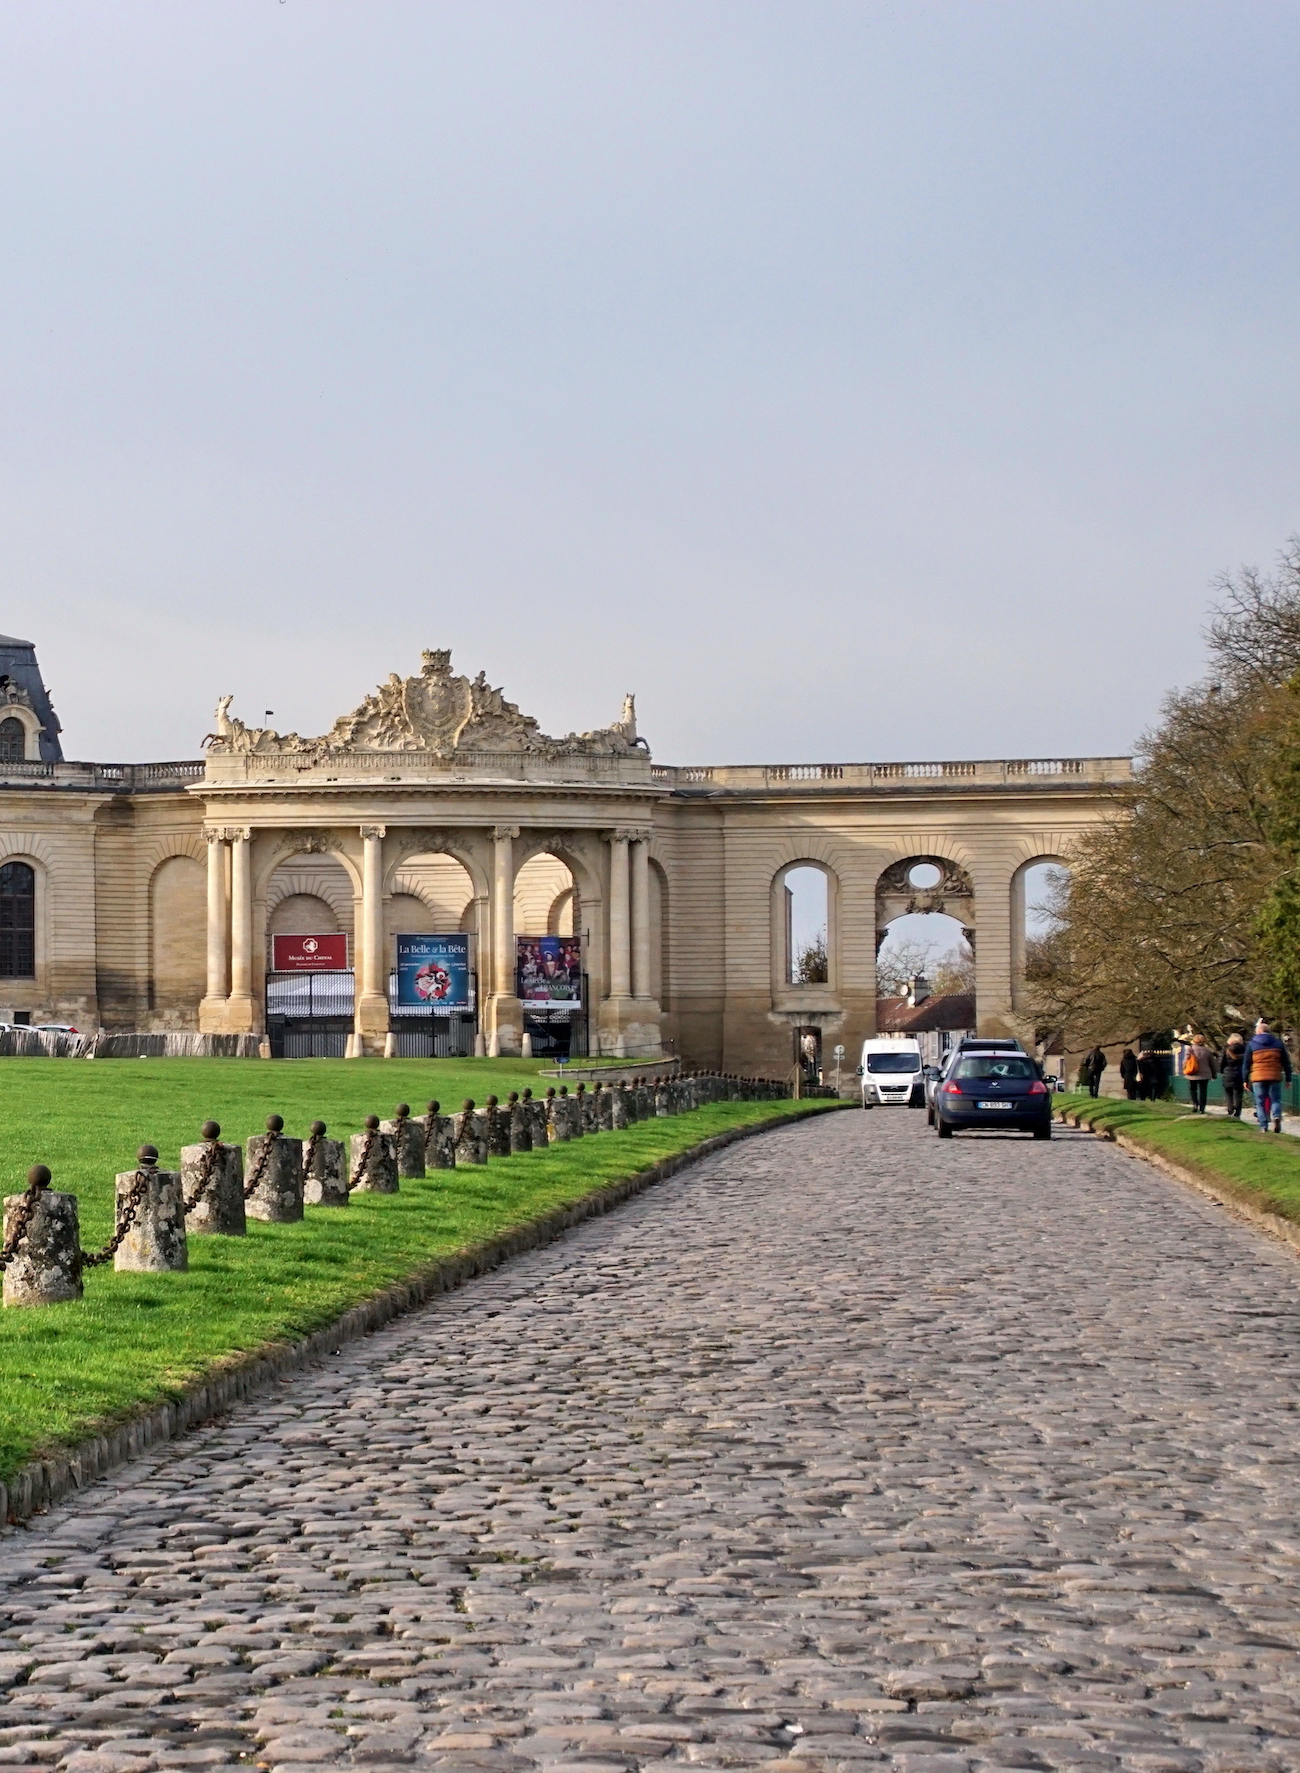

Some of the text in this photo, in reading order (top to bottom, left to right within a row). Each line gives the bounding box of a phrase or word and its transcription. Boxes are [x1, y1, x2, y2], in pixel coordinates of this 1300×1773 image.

[399, 945, 409, 953] La
[411, 944, 430, 953] Belle
[439, 944, 446, 953] la
[448, 944, 466, 953] Bête
